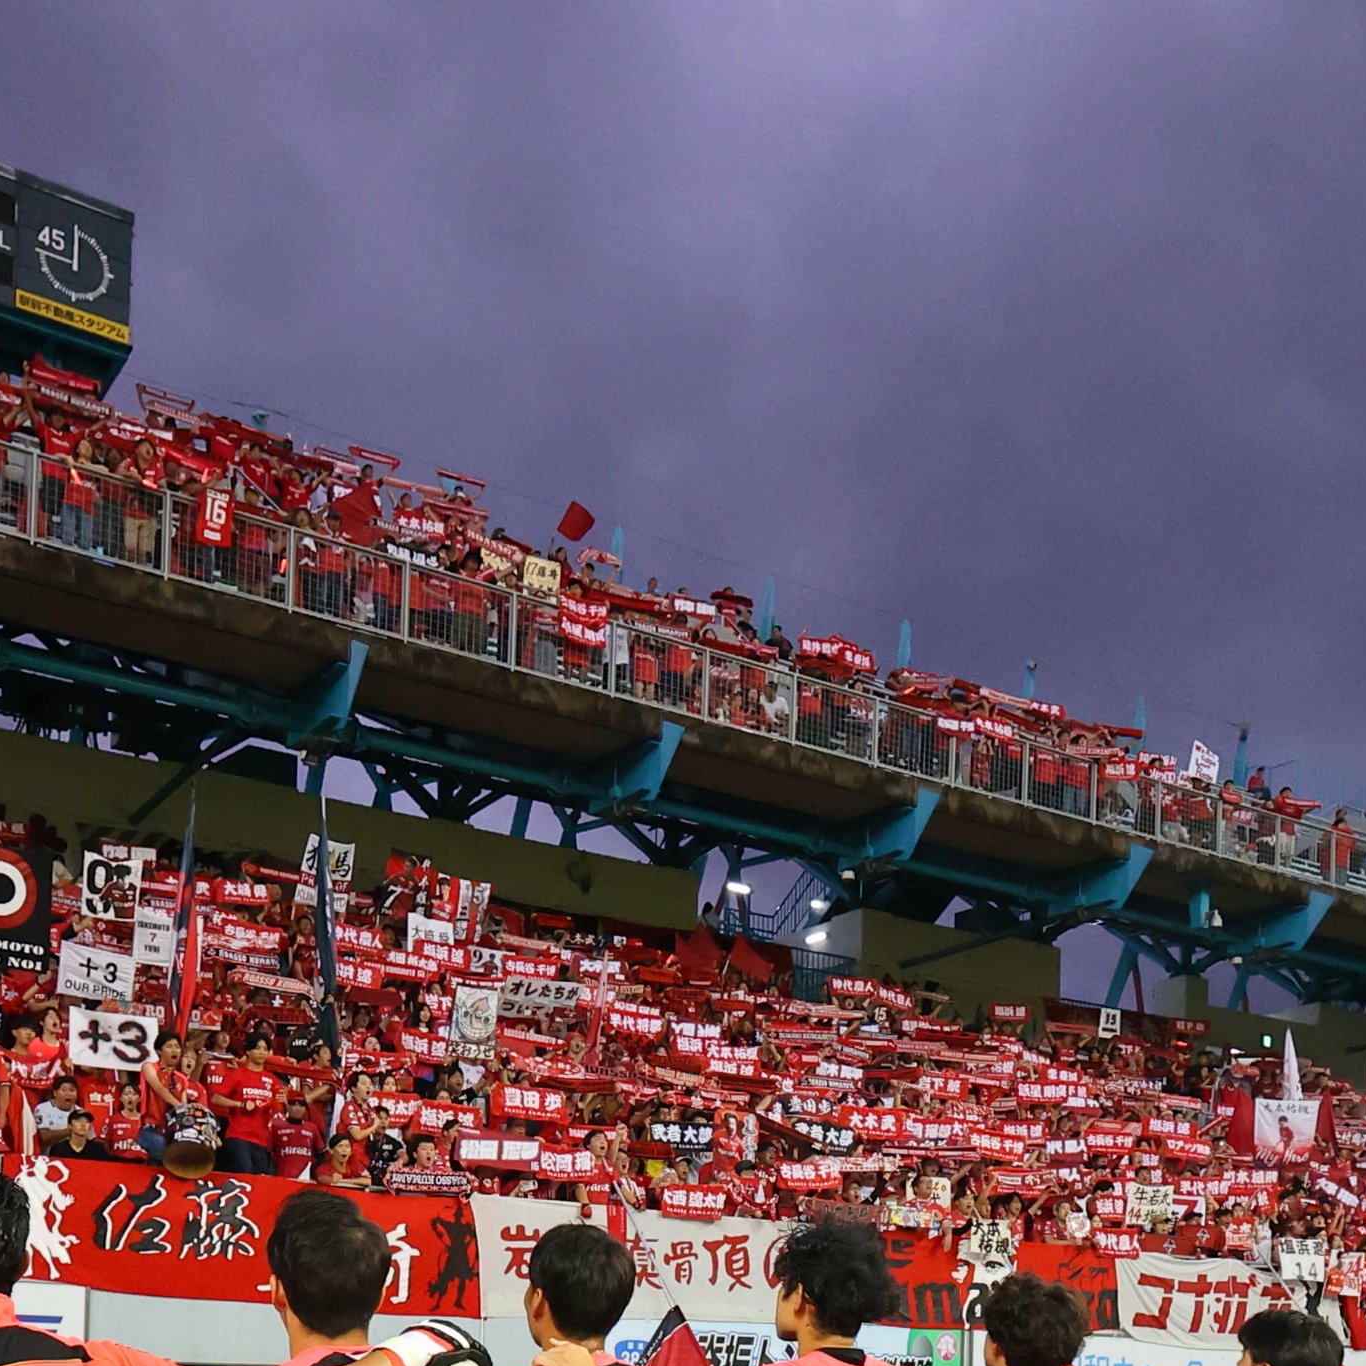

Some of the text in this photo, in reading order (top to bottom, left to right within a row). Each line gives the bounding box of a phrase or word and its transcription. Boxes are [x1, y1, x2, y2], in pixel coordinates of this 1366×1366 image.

[37, 226, 65, 252] 45
[19, 294, 127, 340] 駅前不動産スタジアム
[205, 499, 227, 523] 16
[383, 885, 403, 909] 7
[149, 932, 158, 944] 7
[6, 956, 43, 972] NOI
[472, 949, 483, 964] 9
[78, 956, 119, 984] +3
[64, 978, 128, 1000] OUR PRIDE
[509, 980, 579, 1001] オレたちが
[873, 1006, 887, 1022] 15
[77, 1019, 151, 1064] +3
[503, 1086, 564, 1111] 豊田歩
[849, 1112, 896, 1132] 大木武
[540, 1150, 595, 1174] 松岡瑠
[1283, 1147, 1310, 1164] Hero
[91, 1171, 422, 1306] 佐藤
[971, 1220, 1001, 1237] 大本
[1294, 1261, 1319, 1279] 14
